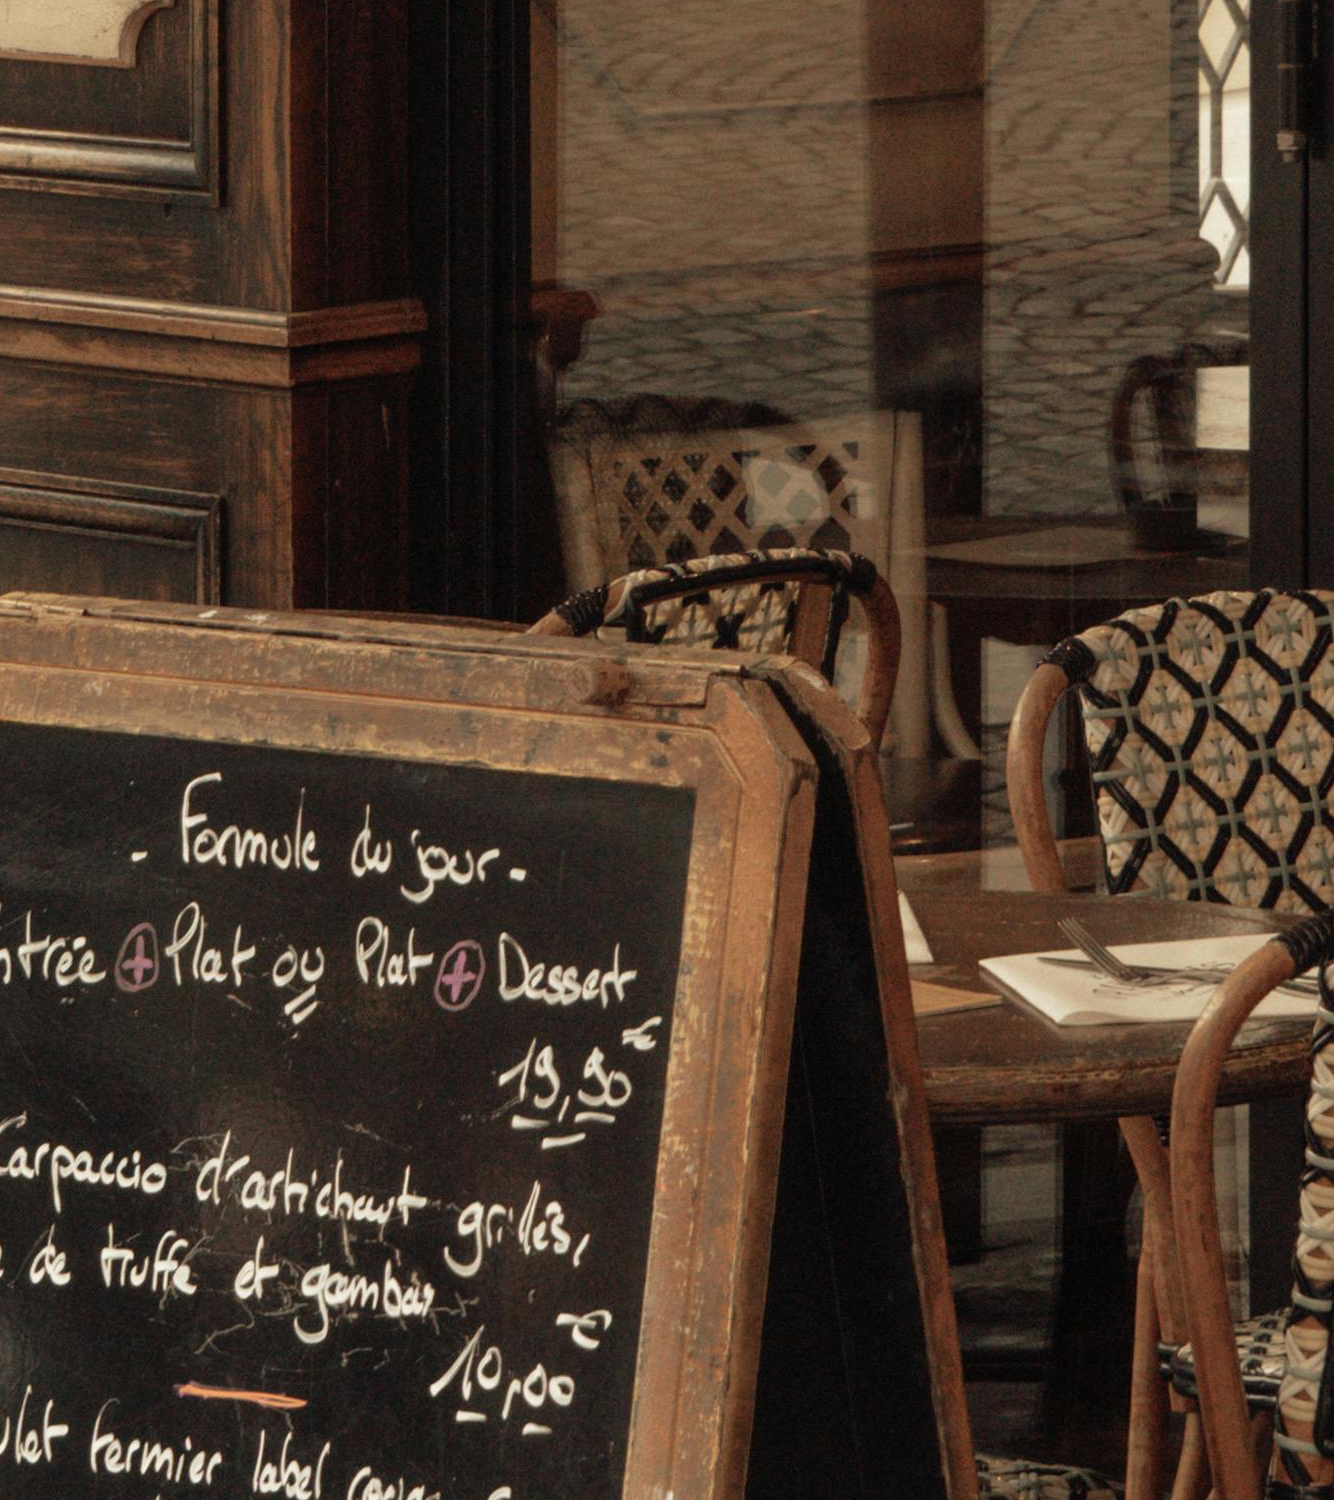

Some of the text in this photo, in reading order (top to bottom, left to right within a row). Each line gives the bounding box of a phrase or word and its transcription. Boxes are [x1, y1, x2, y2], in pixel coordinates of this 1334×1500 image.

[182, 771, 319, 873] Formule
[351, 804, 391, 878] du
[166, 901, 255, 987] Plat
[273, 944, 323, 987] ou
[356, 917, 433, 988] Plat
[498, 931, 637, 1008] Dessert
[196, 1130, 426, 1226] d'artichaut
[29, 1222, 71, 1286] de
[101, 1222, 198, 1298] truffe
[235, 1235, 278, 1300] et
[295, 1263, 435, 1344] gambas
[91, 1397, 223, 1488] fermier
[253, 1430, 330, 1500] label
